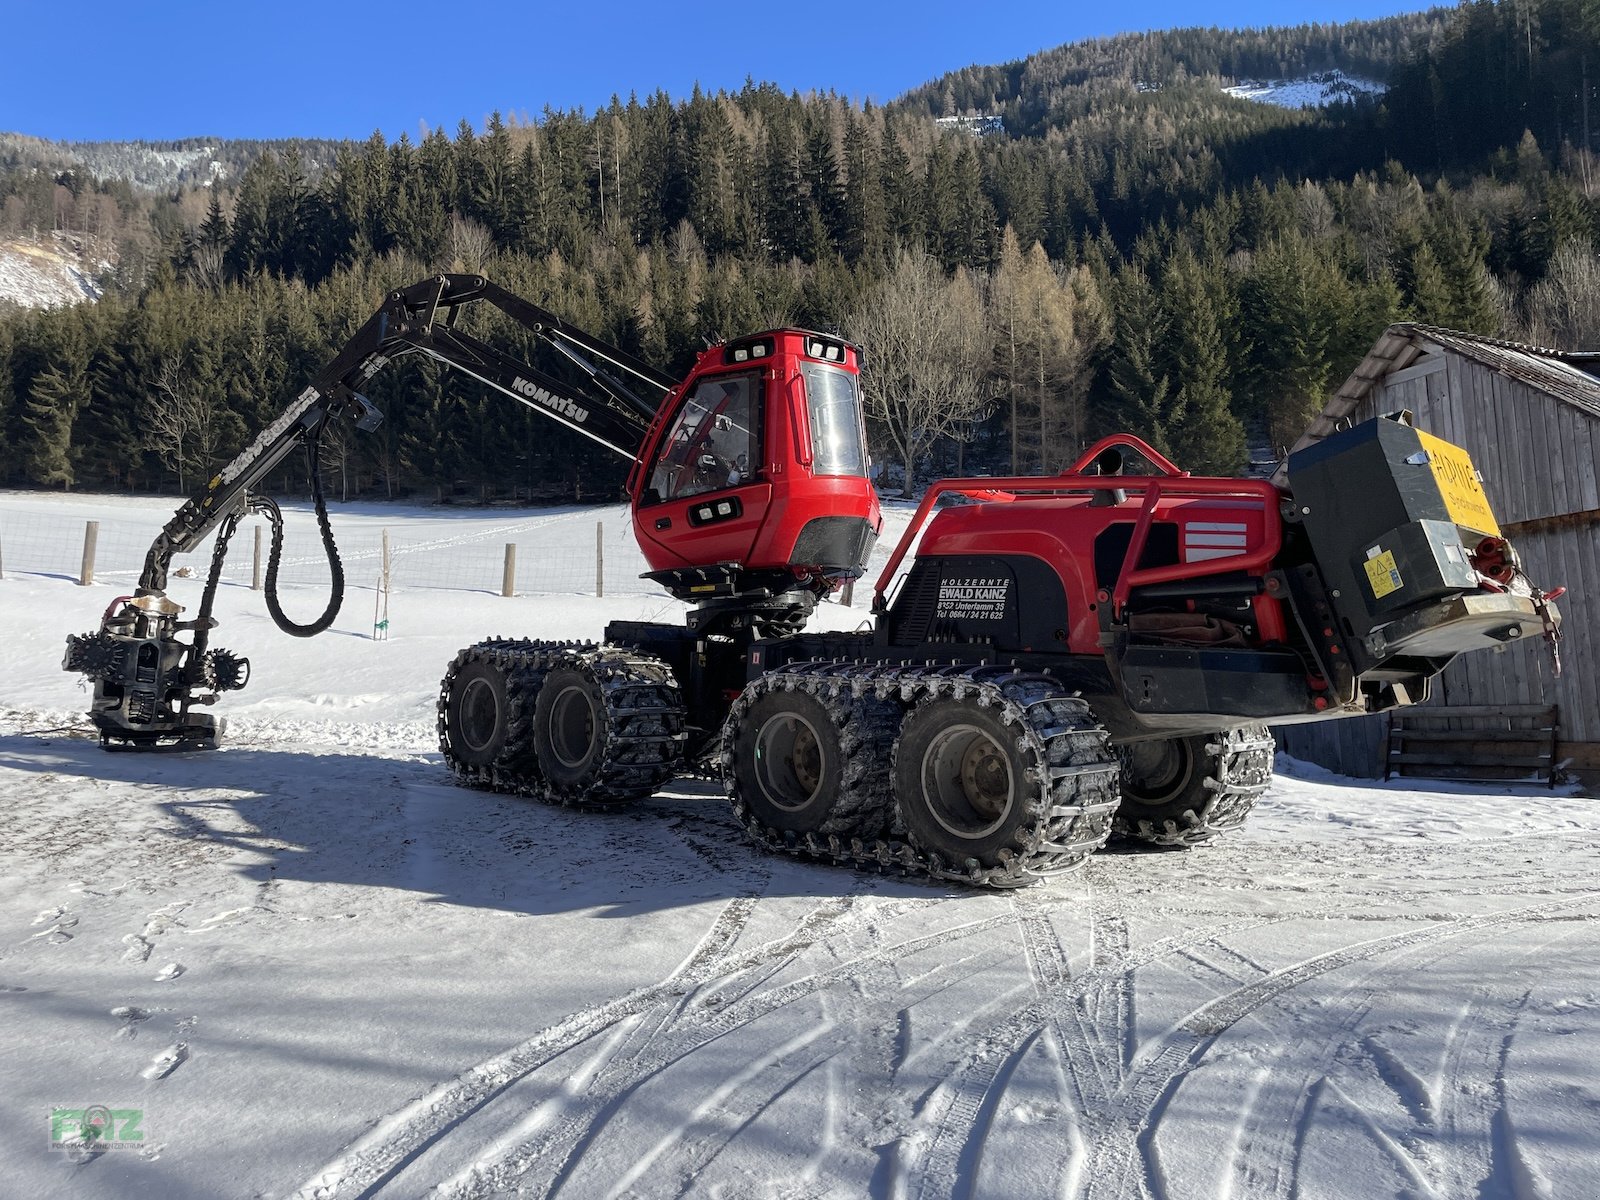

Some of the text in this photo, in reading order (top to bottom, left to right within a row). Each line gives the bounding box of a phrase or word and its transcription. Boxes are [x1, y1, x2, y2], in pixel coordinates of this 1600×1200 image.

[511, 376, 589, 423] KOMATSU
[941, 578, 1010, 586] HOLZERNTE
[939, 588, 1007, 599] EWALD KAINZ
[955, 602, 994, 611] Unterlamm
[990, 611, 1004, 620] 625
